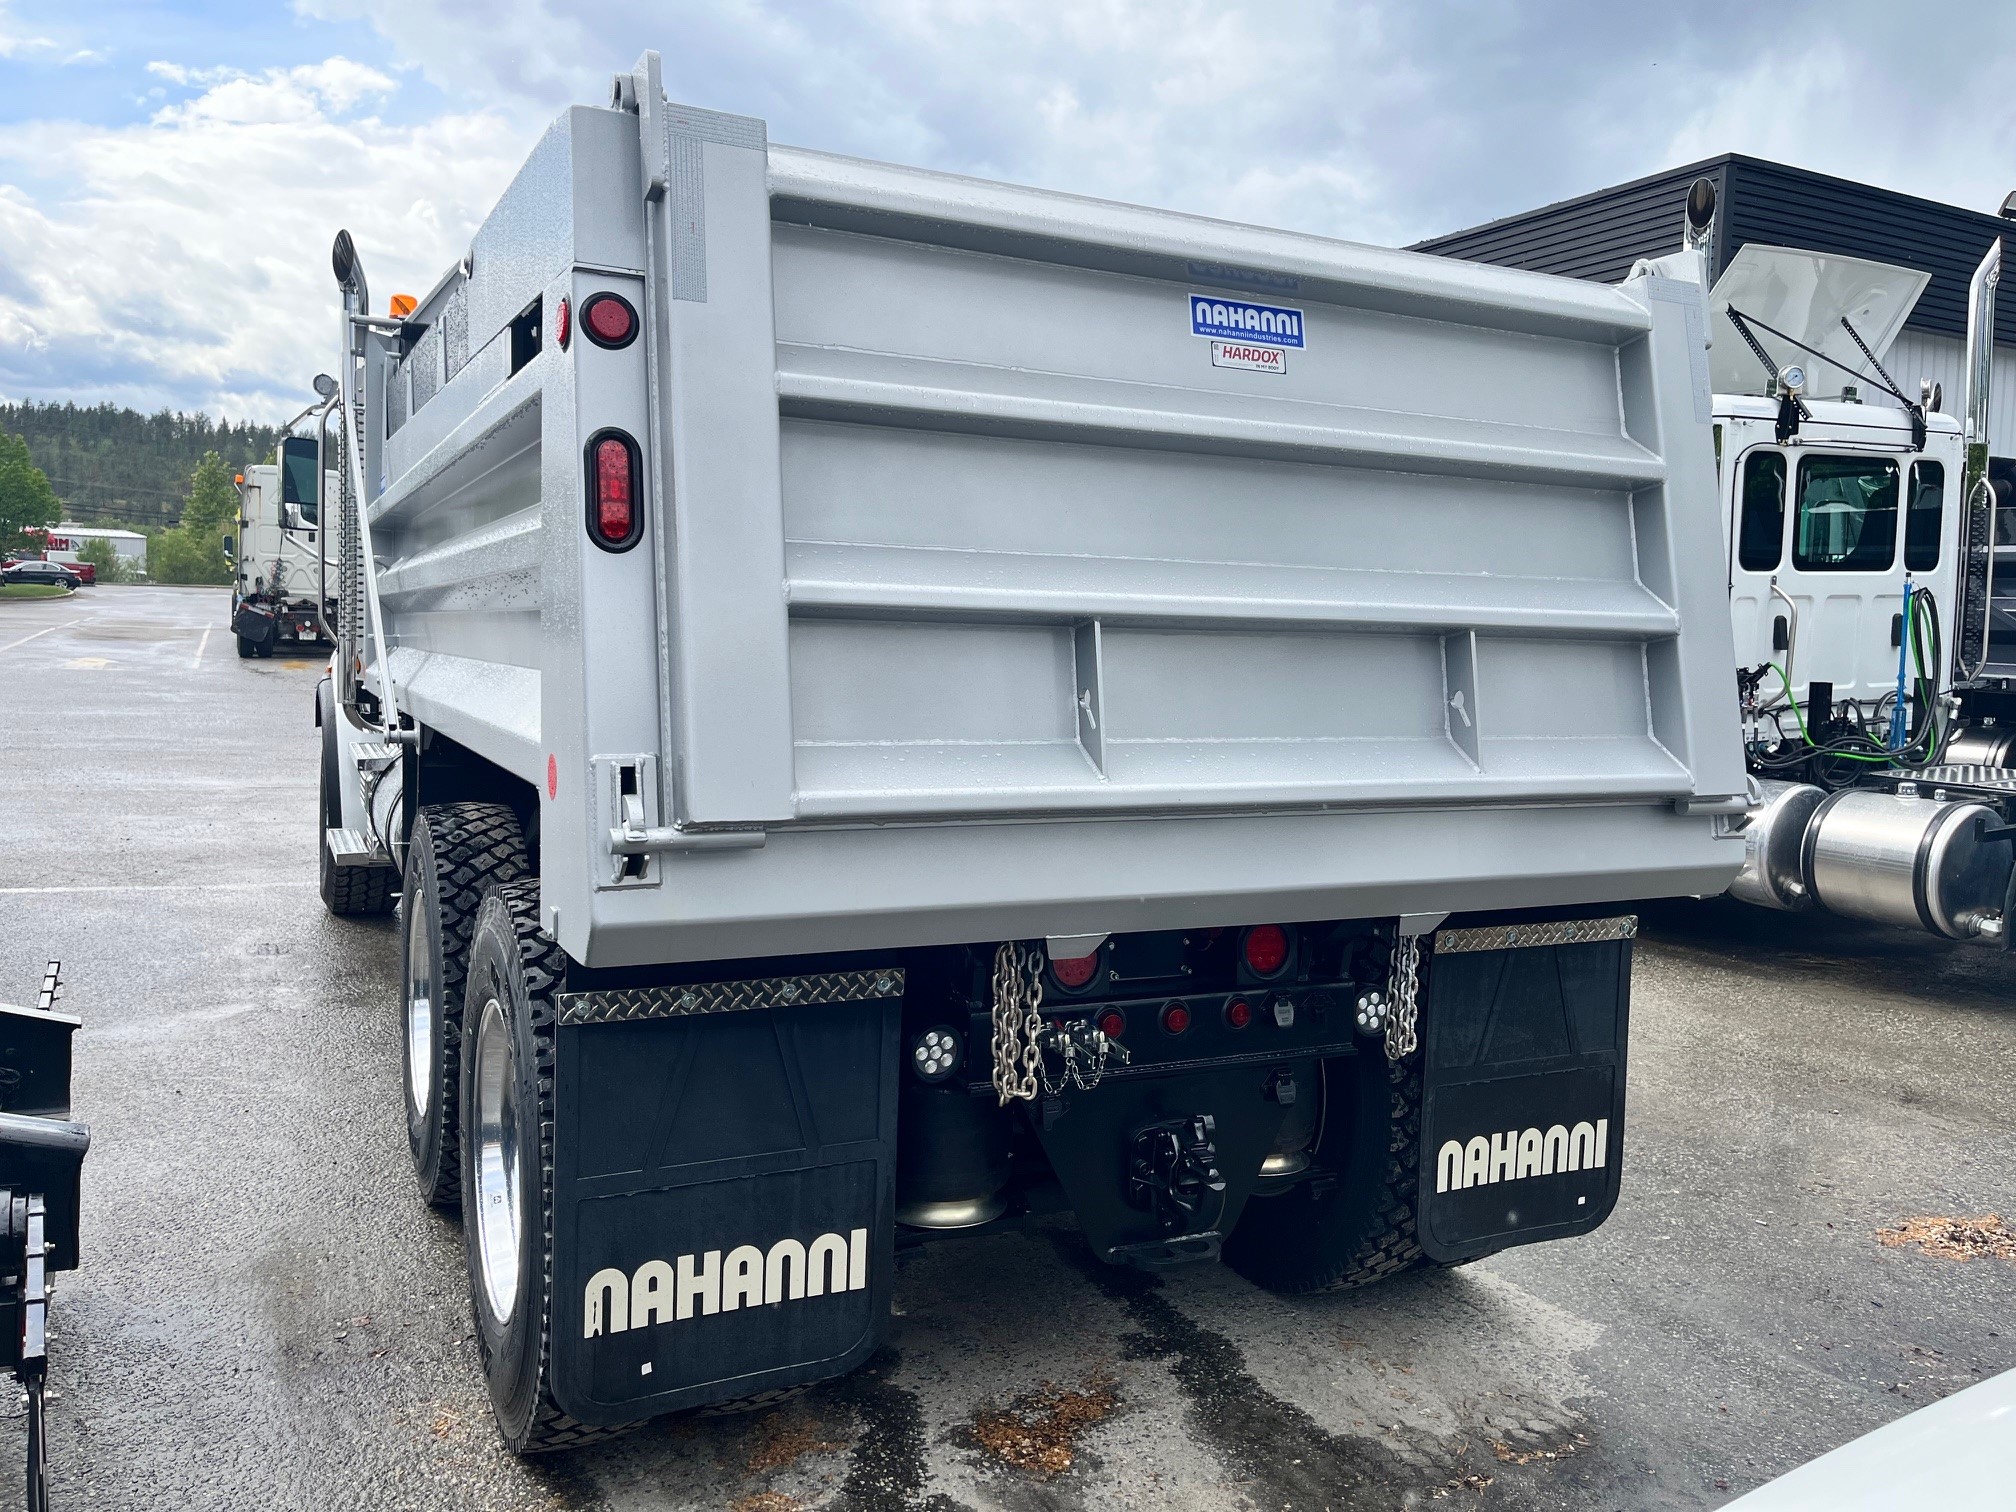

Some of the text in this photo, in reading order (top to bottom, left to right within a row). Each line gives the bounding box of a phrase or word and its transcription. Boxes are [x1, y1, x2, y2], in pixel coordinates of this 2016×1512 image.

[1196, 301, 1299, 337] NAHANNI
[1199, 325, 1298, 345] www.nahanniindustries.com
[1222, 345, 1280, 365] HARDOX
[1436, 1118, 1608, 1194] NAHANNI
[583, 1227, 868, 1340] NAHANNI
